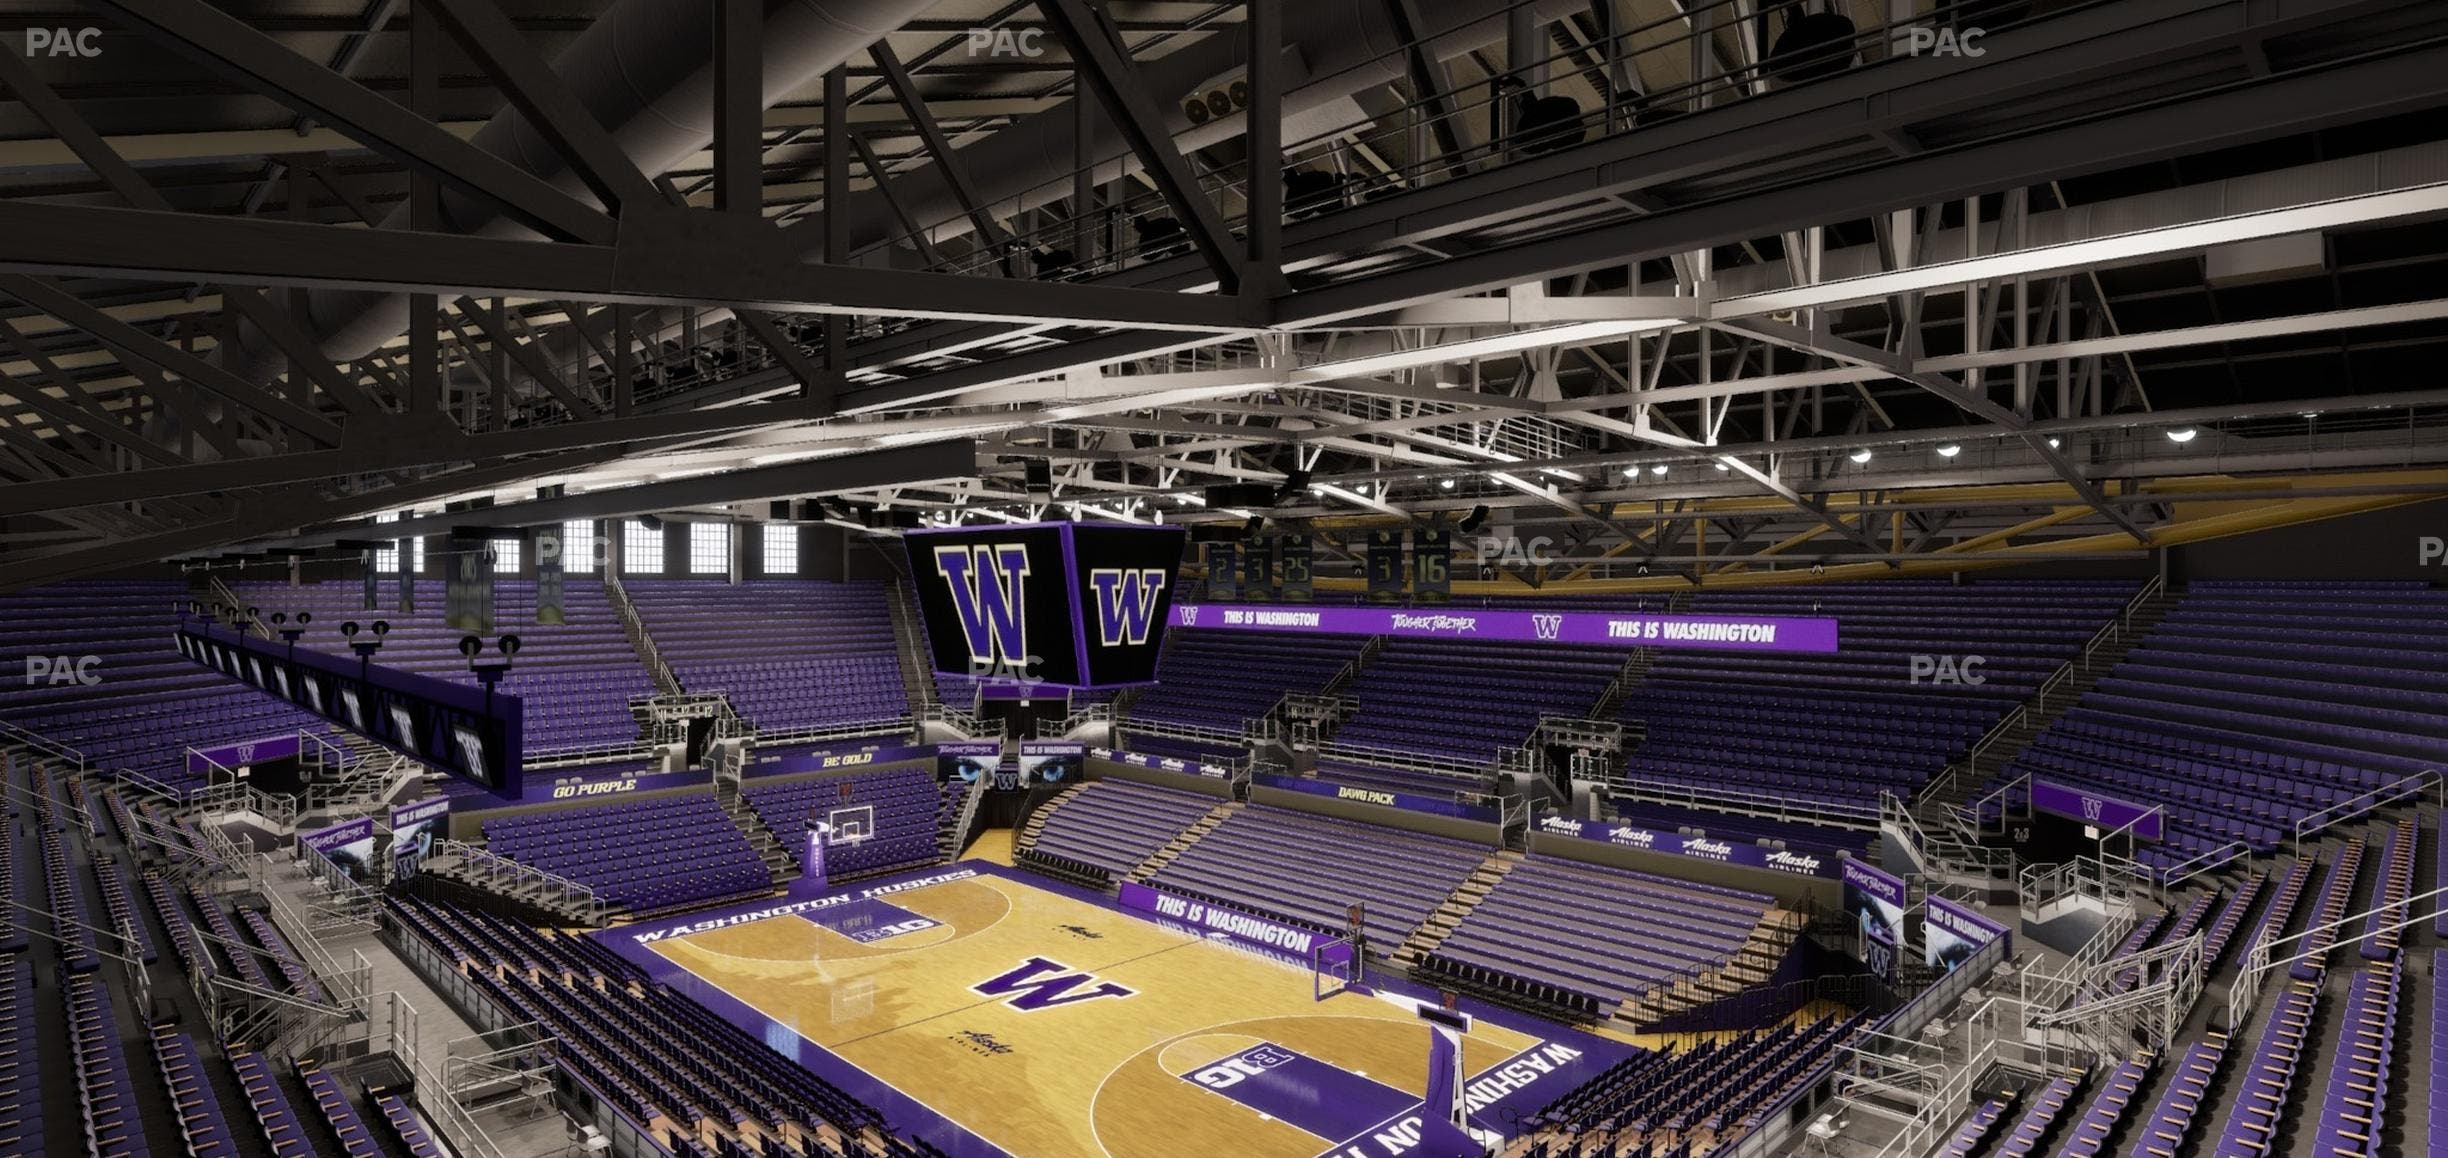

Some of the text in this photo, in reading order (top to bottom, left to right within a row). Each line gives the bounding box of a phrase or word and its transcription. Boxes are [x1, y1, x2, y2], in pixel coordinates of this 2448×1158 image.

[1215, 558, 1228, 584] 2
[1252, 557, 1264, 583] 3
[1284, 556, 1310, 583] 25
[1377, 556, 1391, 583] 3
[1418, 554, 1447, 584] 16
[933, 543, 1031, 667] W
[1090, 568, 1166, 647] W
[1180, 606, 1198, 625] W
[1224, 611, 1320, 626] THIS IS WASHINGTON
[1533, 615, 1561, 639] W
[1608, 620, 1776, 643] THIS IS WASHINGTON
[822, 753, 873, 768] BE GOLD
[553, 779, 637, 799] GO PURPLE
[1338, 786, 1367, 801] DAWG
[1367, 790, 1396, 806] PACK
[2081, 797, 2103, 821] W
[1541, 816, 1583, 831] Alaska
[1543, 826, 1579, 837] AIRLINES
[1608, 827, 1654, 843] Alaska
[1612, 838, 1650, 849] AIRLINES
[1682, 838, 1731, 855] Alaska
[1685, 849, 1727, 861] AIRLINES
[1765, 851, 1820, 869] Alaska
[1768, 863, 1815, 876] AIRLINES
[632, 868, 978, 944] WASHINGTON HUSKIES
[1929, 904, 1945, 923] THIS
[1945, 911, 1952, 925] IS
[1156, 894, 1313, 954] THIS IS WASHINGTON
[966, 955, 1141, 1012] W
